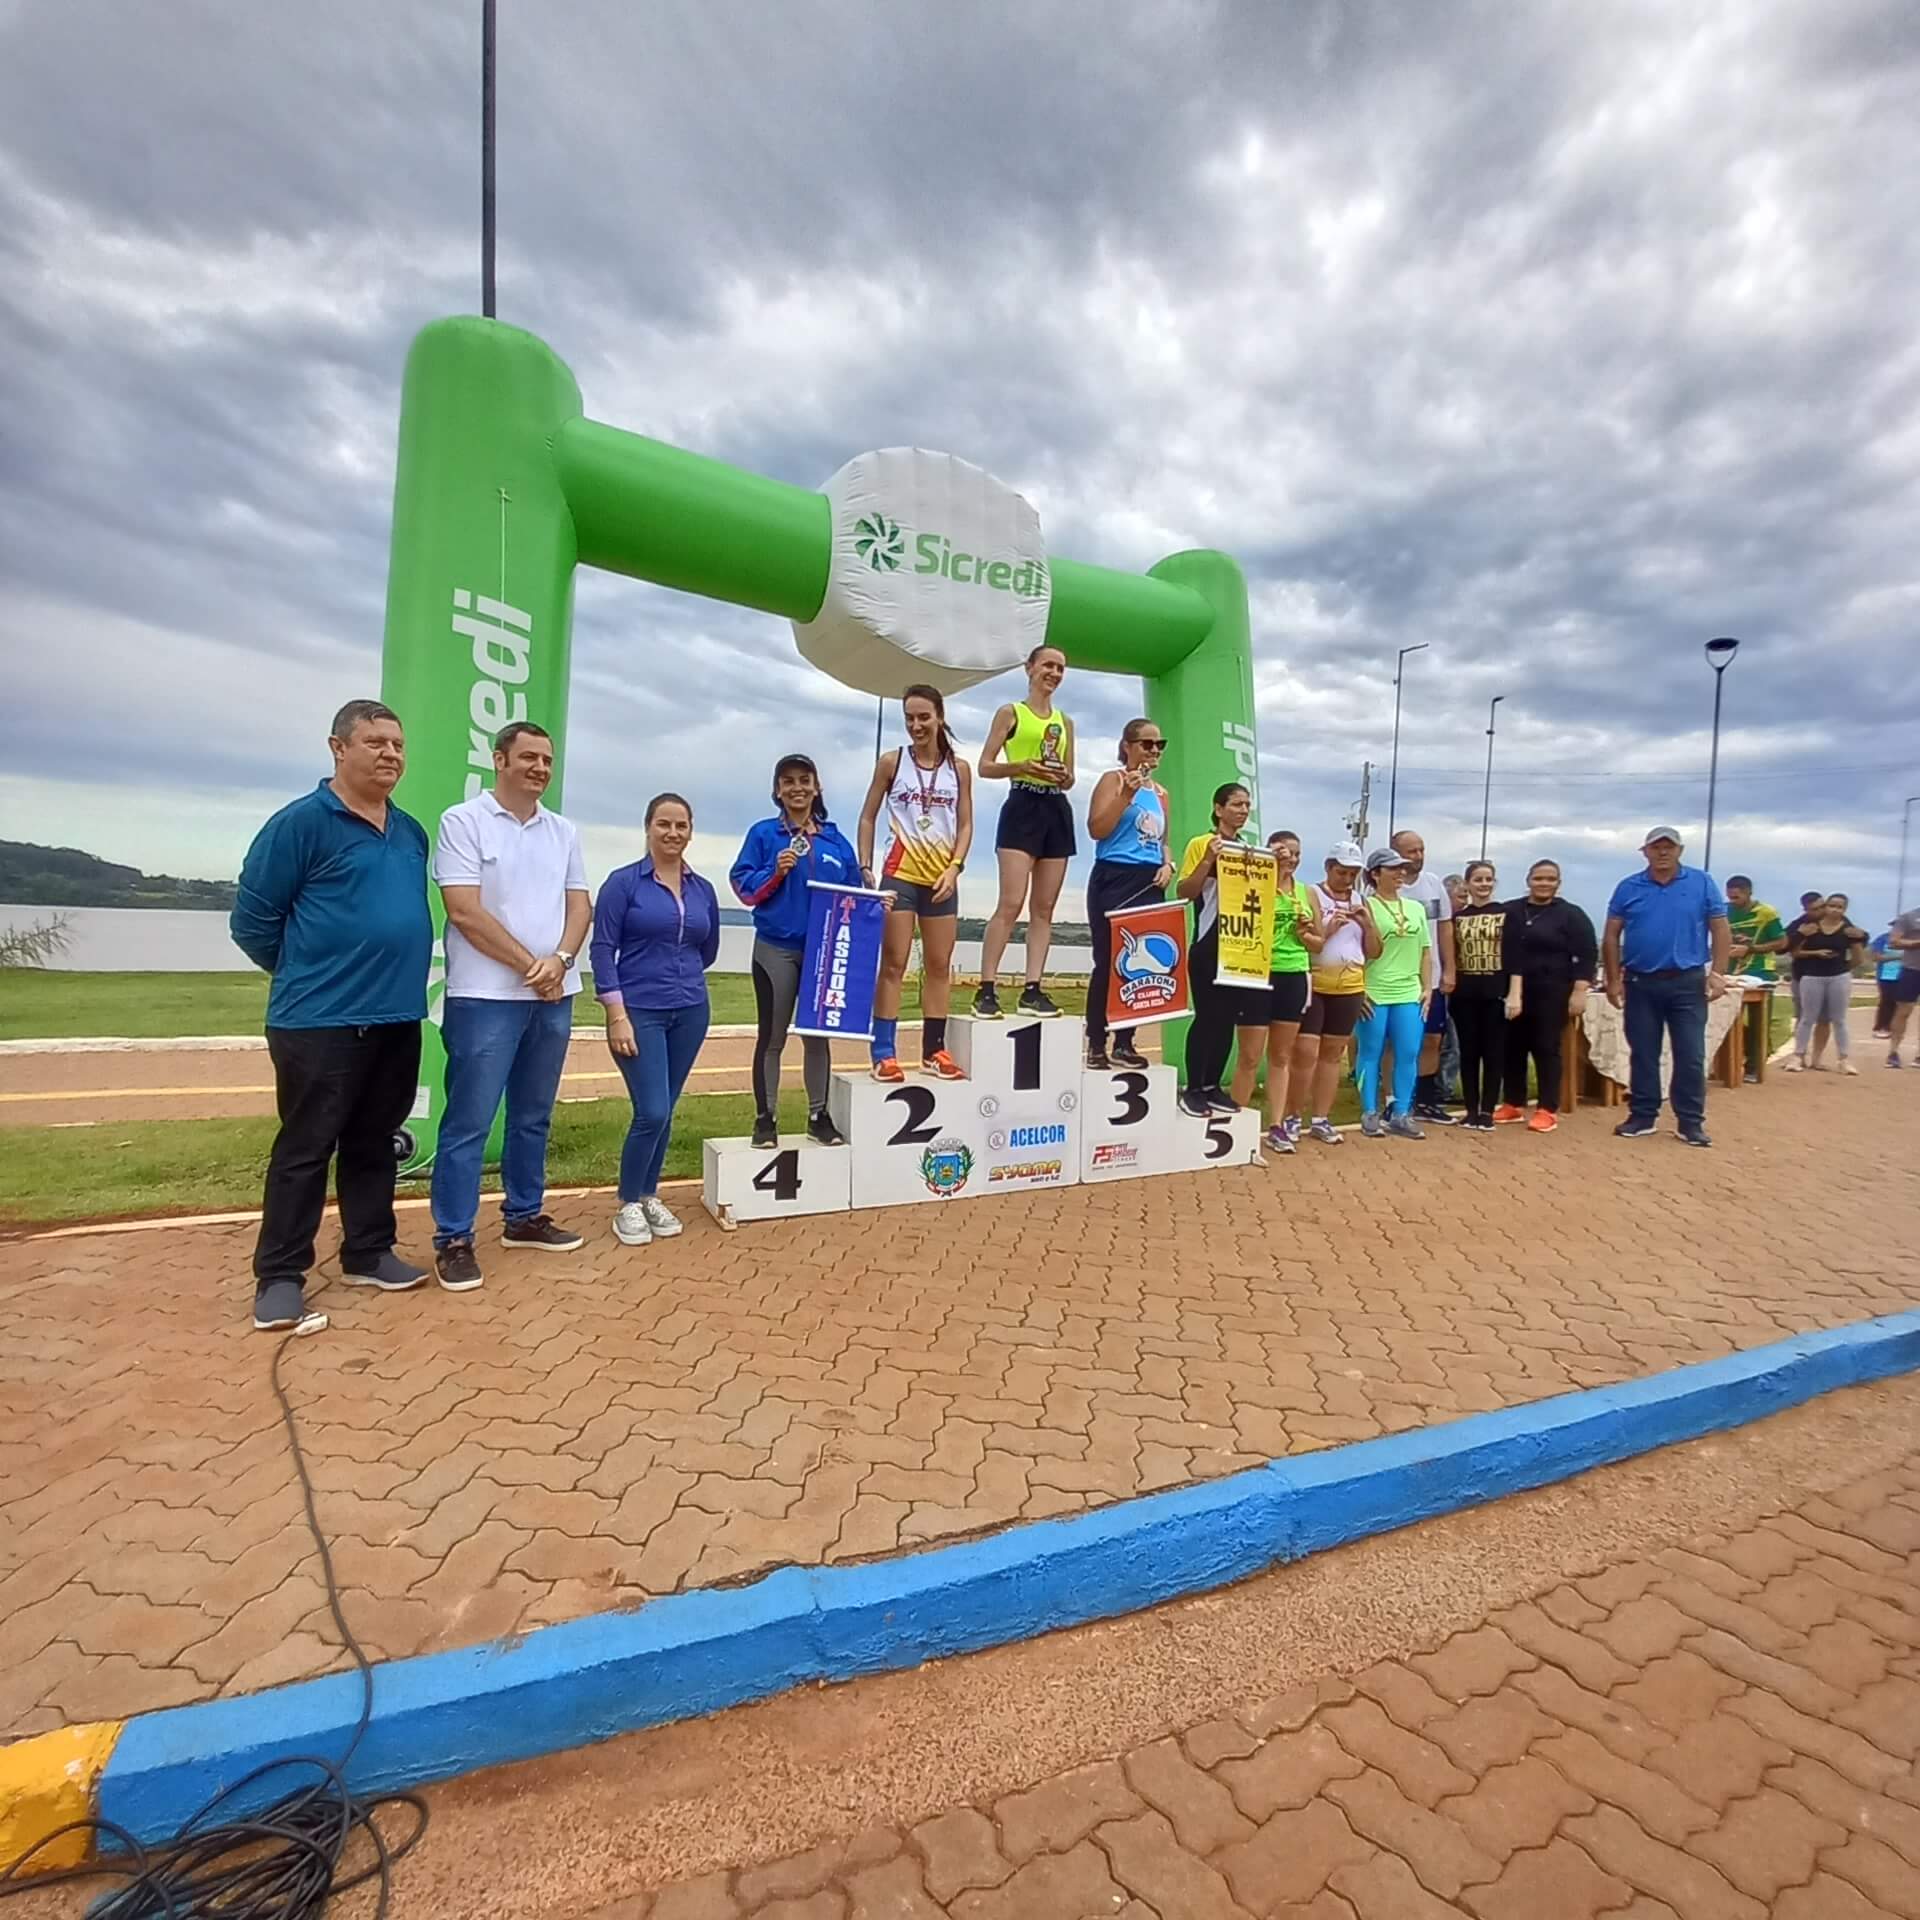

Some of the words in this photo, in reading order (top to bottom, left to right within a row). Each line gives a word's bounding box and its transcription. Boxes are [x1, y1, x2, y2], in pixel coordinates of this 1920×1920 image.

[914, 533, 1043, 597] Sicredi
[1223, 867, 1269, 881] ESPOTIVA
[1218, 912, 1254, 939] RUN
[1121, 975, 1175, 997] MARATONA
[1137, 989, 1161, 999] CLUBE
[1005, 1021, 1042, 1091] 1
[885, 1085, 943, 1147] 2
[1107, 1071, 1150, 1126] 3
[1009, 1124, 1066, 1147] ACELCOR
[1204, 1115, 1235, 1159] 5
[751, 1149, 802, 1201] 4
